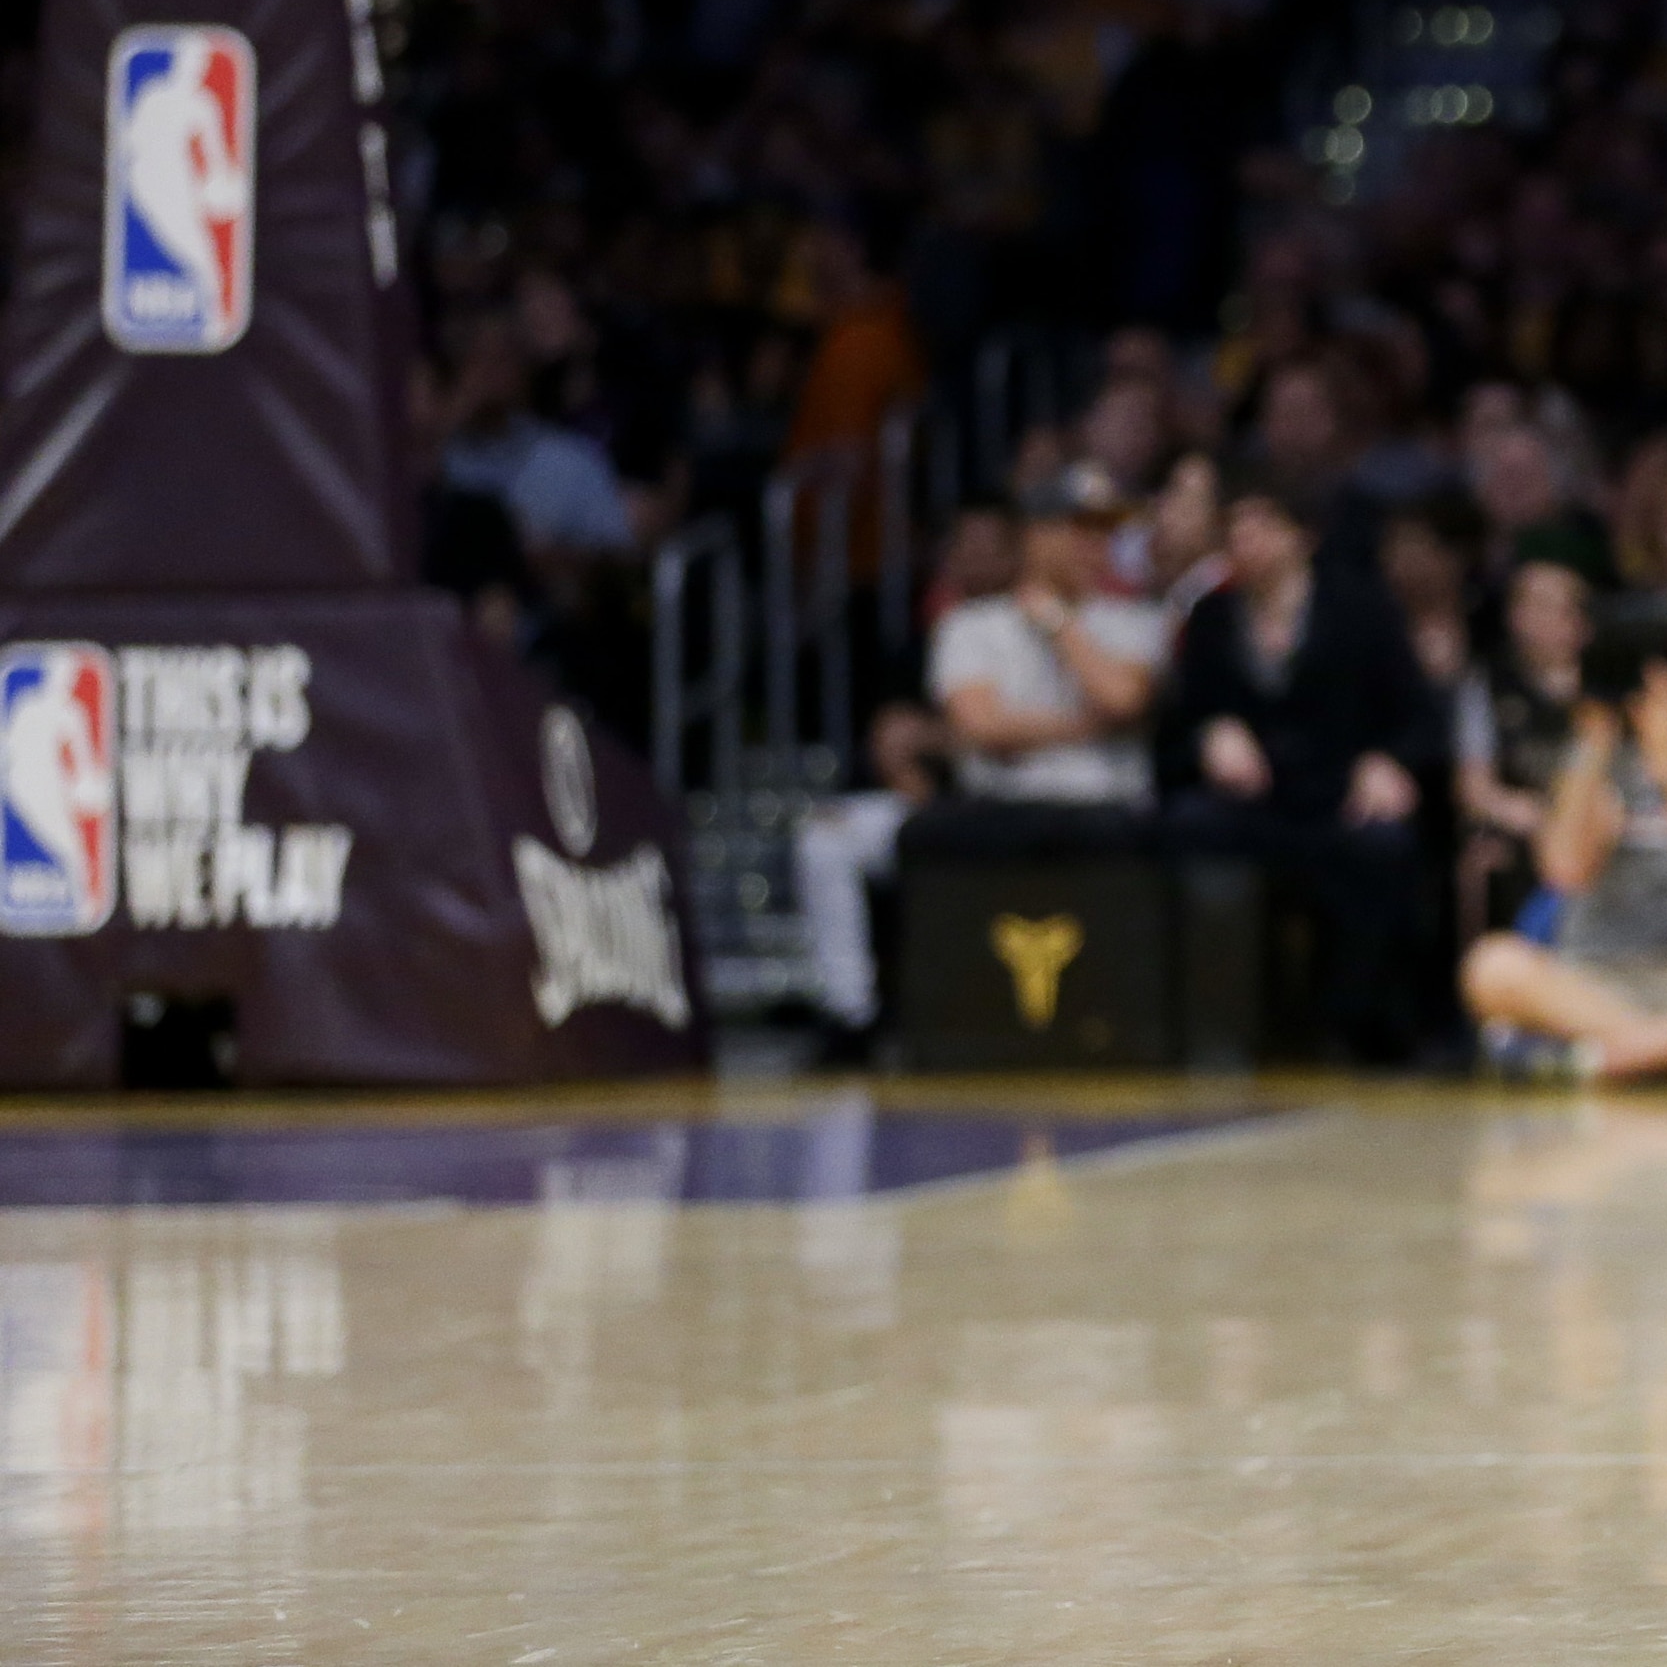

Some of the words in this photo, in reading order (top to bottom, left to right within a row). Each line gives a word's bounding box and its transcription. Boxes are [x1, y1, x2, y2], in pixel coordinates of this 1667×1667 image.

[118, 645, 246, 739] THIS
[247, 644, 313, 753] IS
[126, 831, 212, 930] WE
[213, 823, 354, 930] PLAY
